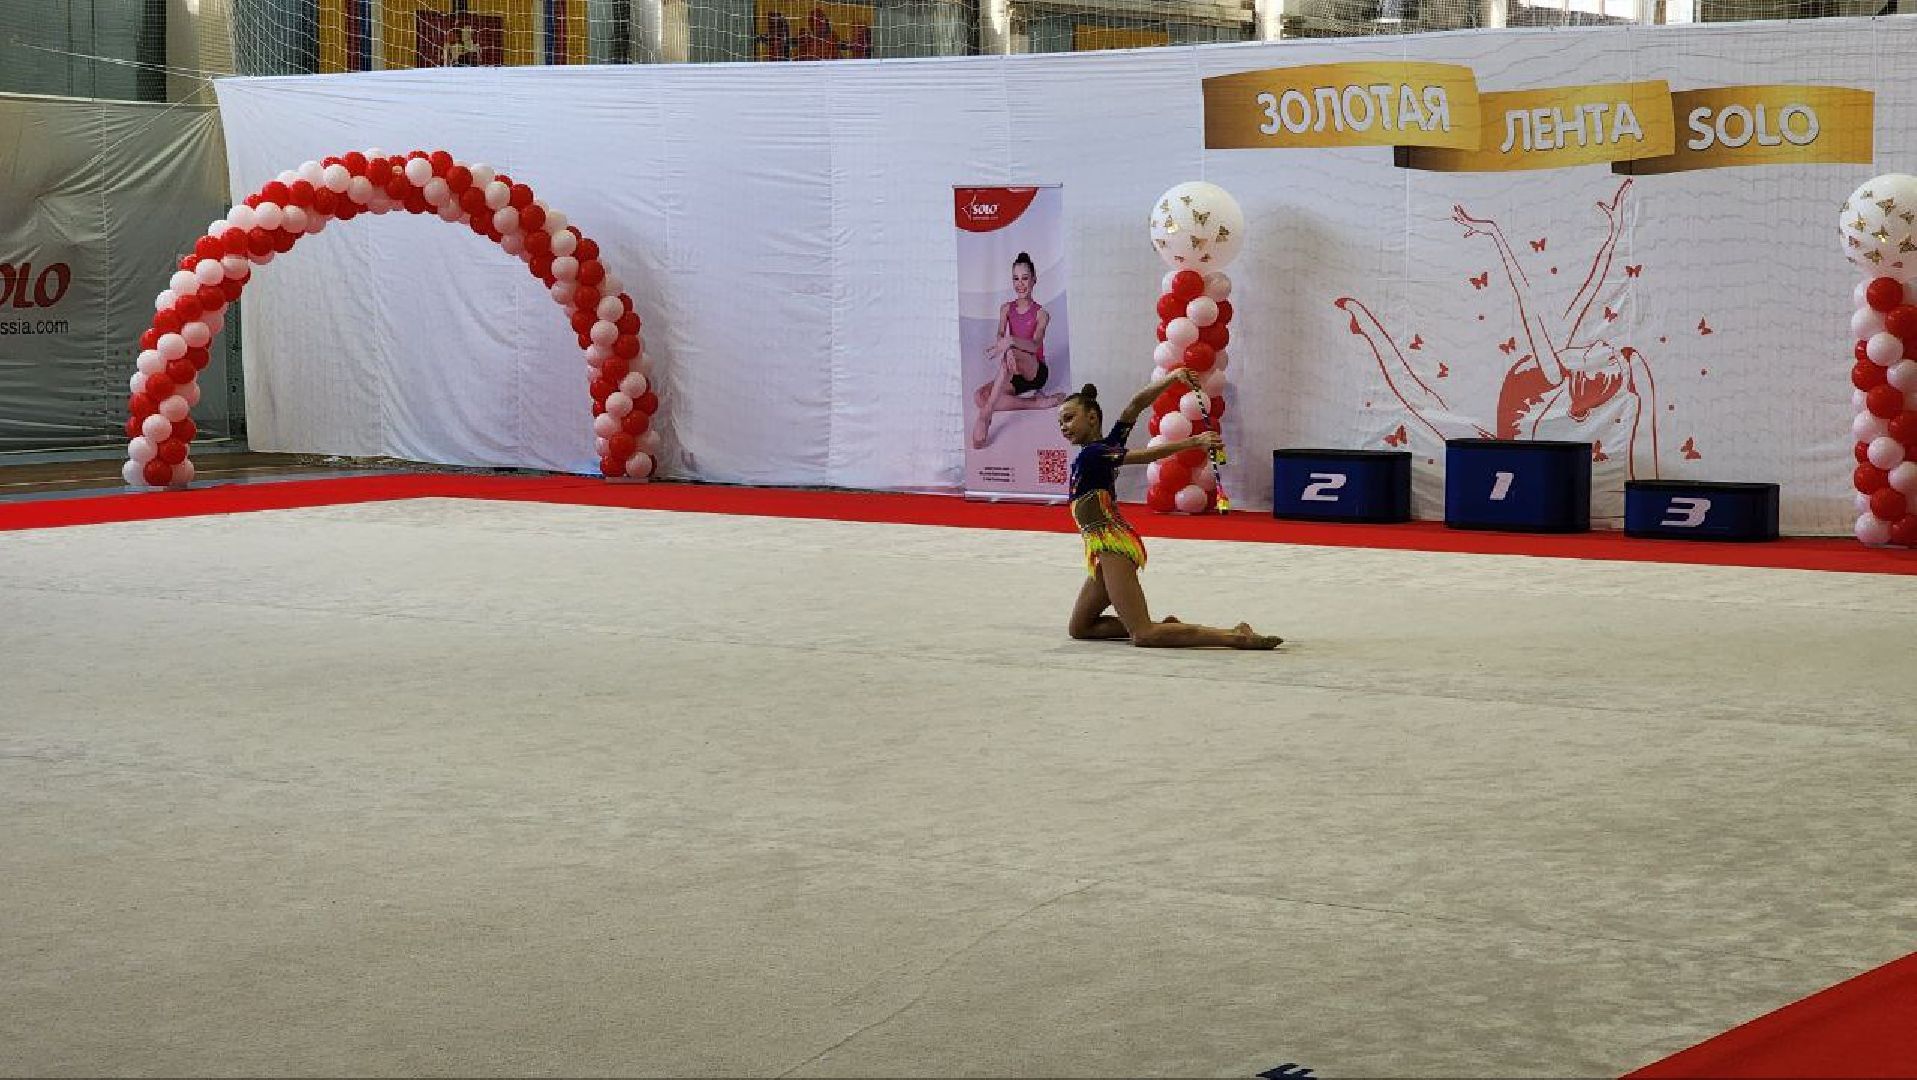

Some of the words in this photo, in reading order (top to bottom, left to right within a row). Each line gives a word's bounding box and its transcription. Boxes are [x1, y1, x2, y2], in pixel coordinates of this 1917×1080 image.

[1256, 84, 1450, 135] ЗОЛОТАЯ
[1501, 101, 1644, 153] ЛЕНТА
[1687, 103, 1820, 151] SOLO
[972, 203, 998, 215] SOLO
[1301, 473, 1347, 501] 2
[1489, 471, 1514, 501] 1
[1660, 497, 1711, 527] 3
